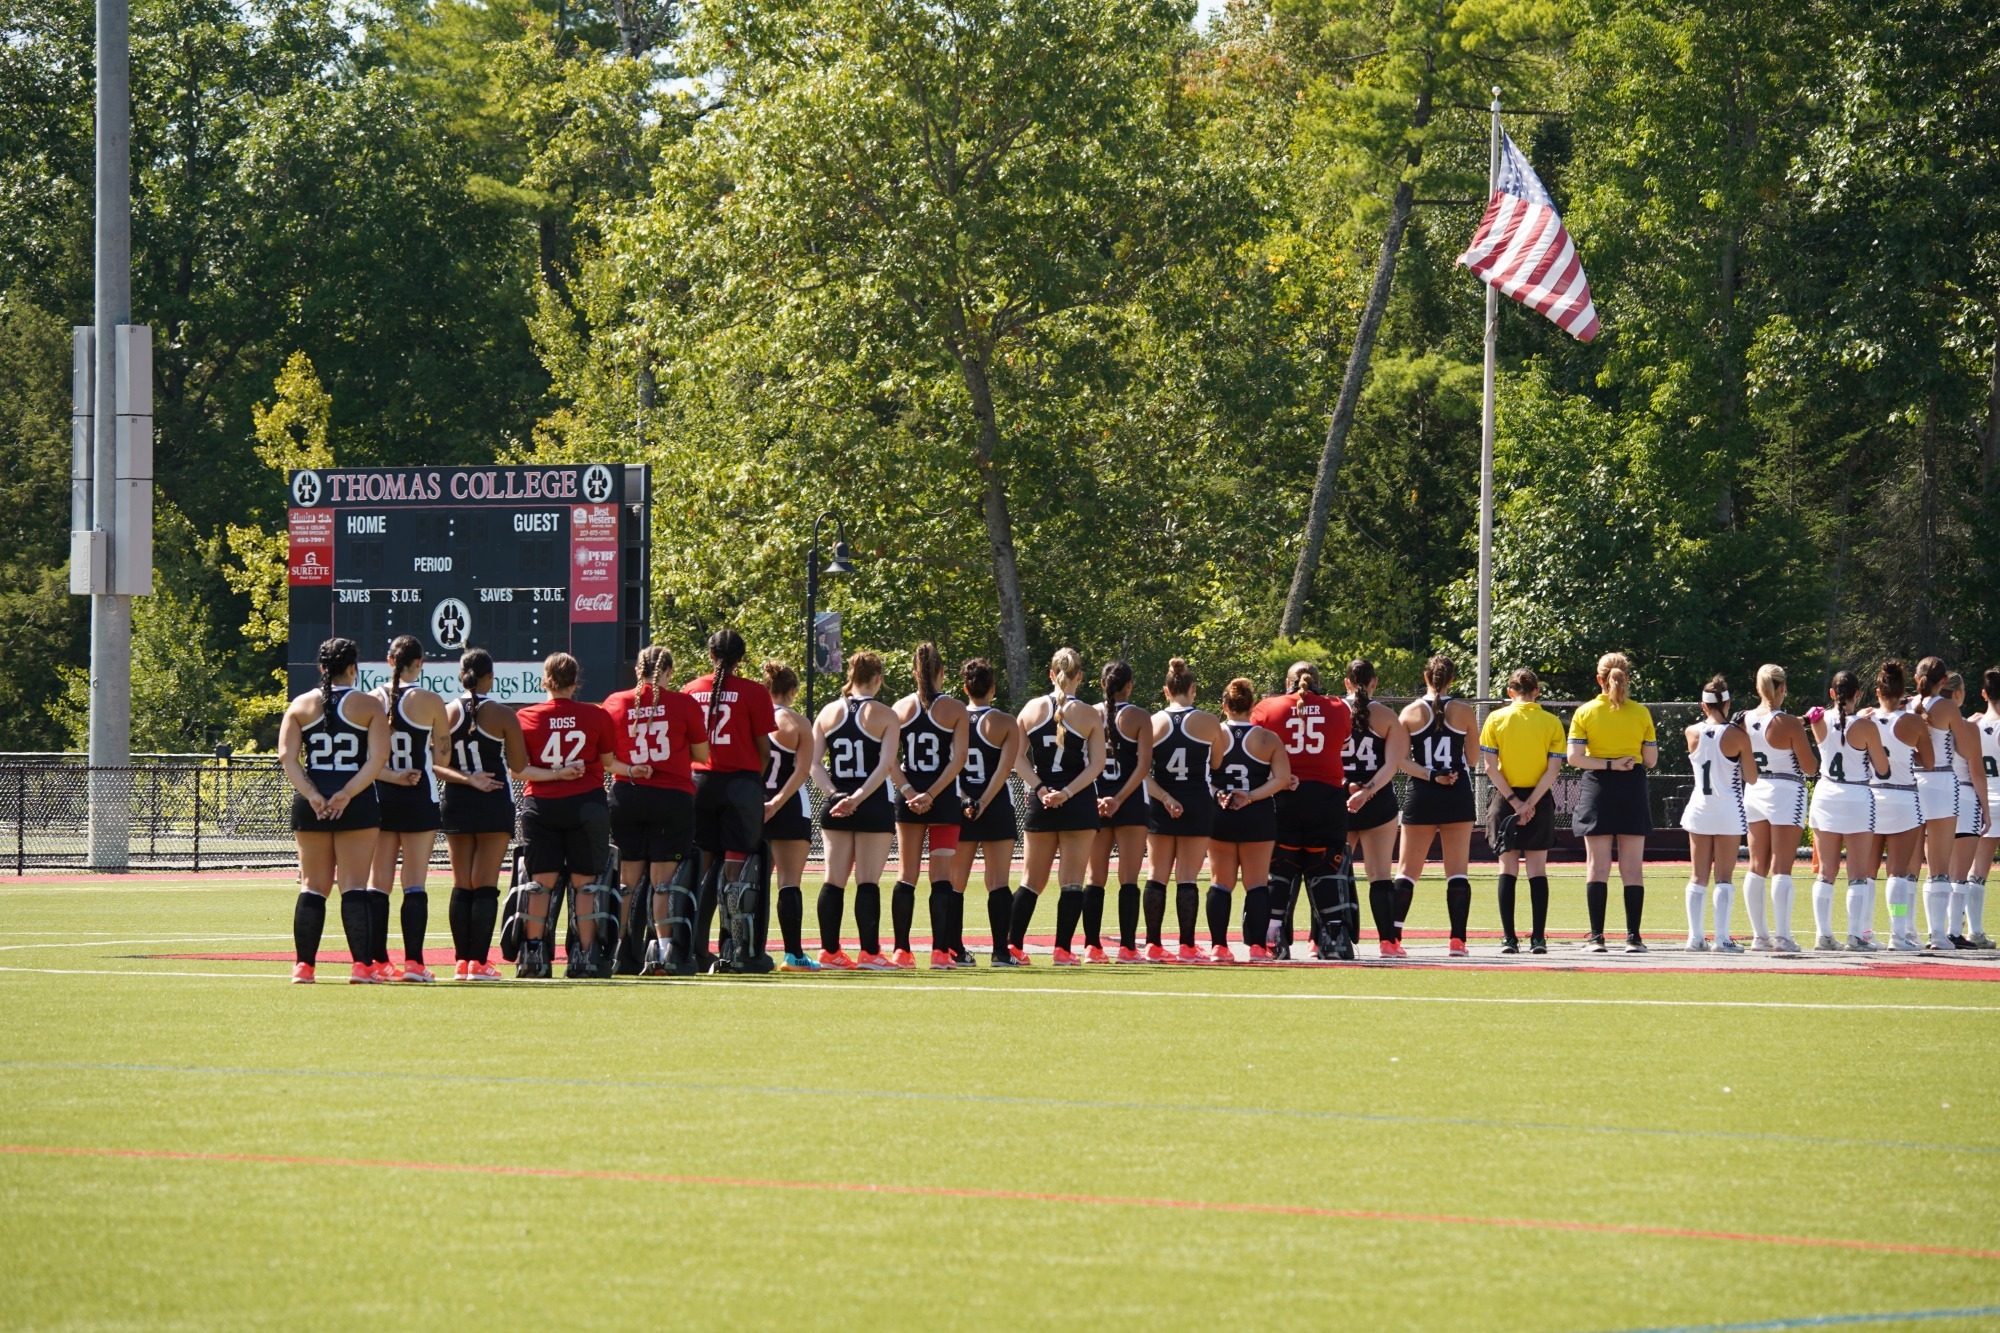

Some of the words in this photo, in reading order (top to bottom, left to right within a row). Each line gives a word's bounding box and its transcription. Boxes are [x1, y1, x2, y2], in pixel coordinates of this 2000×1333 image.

[326, 473, 441, 501] THOMAS
[450, 470, 578, 499] COLLEGE
[347, 515, 386, 534] HOME
[513, 513, 560, 532] GUEST
[588, 514, 616, 524] Western
[594, 506, 609, 516] Best
[291, 566, 330, 576] SURETTE
[414, 557, 452, 572] PERIOD
[339, 589, 370, 602] SAVES
[391, 589, 421, 602] S.O.G.
[480, 588, 513, 602] SAVES
[533, 588, 565, 601] S.O.G.
[549, 717, 576, 729] ROSS
[628, 705, 665, 720] REGIS
[309, 733, 359, 770] 22
[541, 730, 586, 768] 42
[628, 721, 670, 764] 33
[907, 732, 939, 771] 13
[1285, 717, 1325, 754] 35
[455, 740, 485, 774] 11
[833, 738, 867, 777] 21
[963, 748, 986, 784] 9
[1043, 735, 1065, 772] 7
[1166, 747, 1189, 780] 4
[1341, 736, 1377, 771] 24
[1424, 736, 1452, 769] 14
[1829, 752, 1846, 782] 4
[1225, 764, 1250, 791] 3
[1702, 760, 1713, 795] 1
